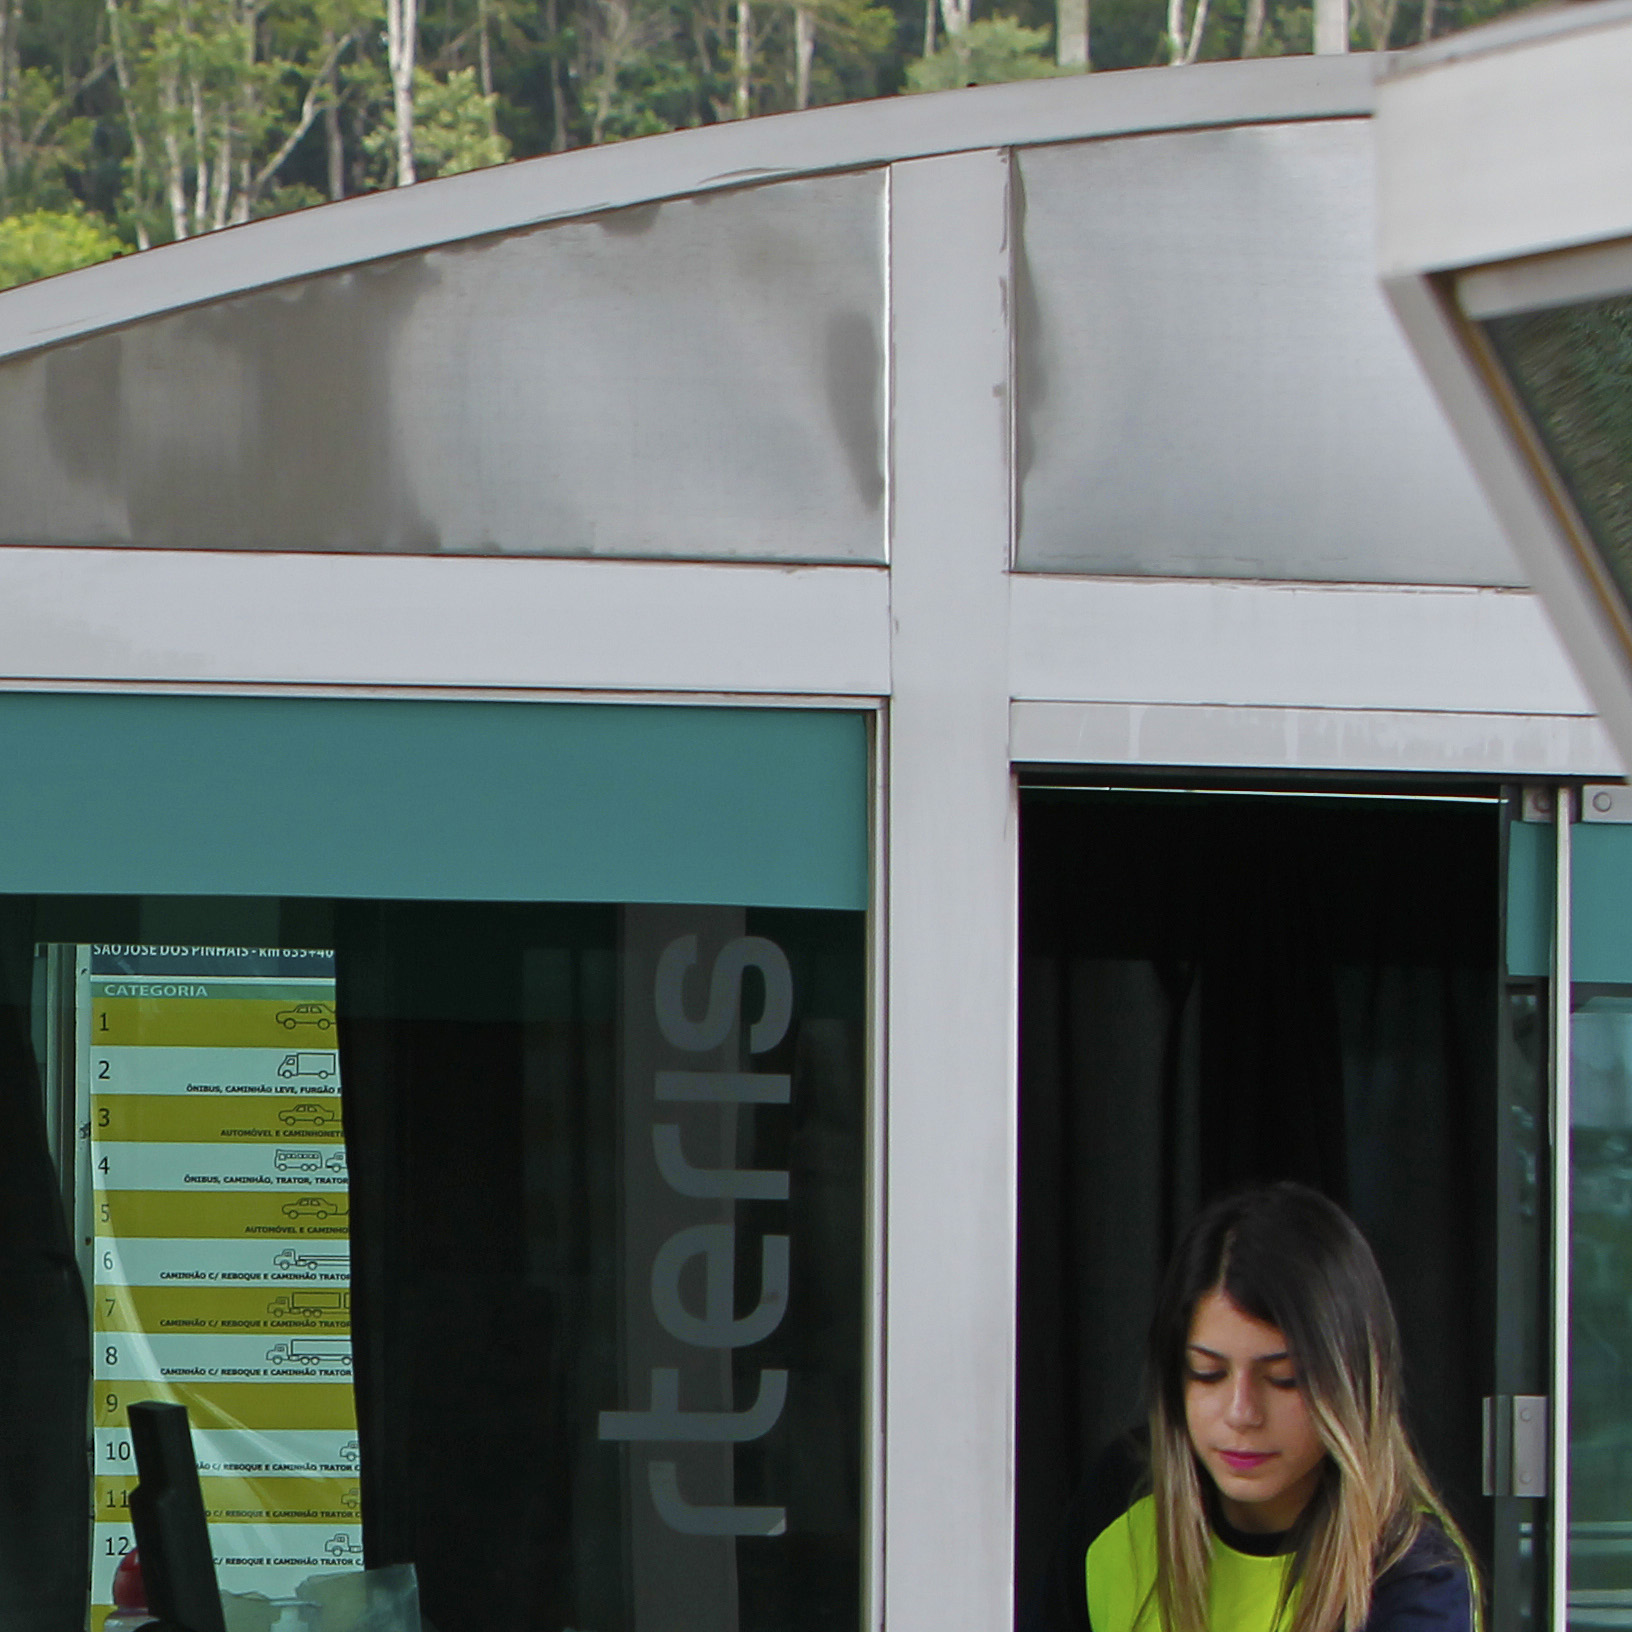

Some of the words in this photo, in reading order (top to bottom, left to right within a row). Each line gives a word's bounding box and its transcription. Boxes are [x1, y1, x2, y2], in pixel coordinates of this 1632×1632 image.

[104, 984, 208, 997] CATEGORIA
[99, 1012, 110, 1031] 1
[98, 1060, 111, 1080] 2
[98, 1108, 111, 1127] 3
[98, 1156, 111, 1175] 4
[100, 1203, 111, 1223] 5
[598, 934, 794, 1537] rteris
[103, 1251, 114, 1270] 6
[105, 1298, 116, 1317] 7
[105, 1346, 118, 1365] 8
[106, 1393, 118, 1412] 9
[106, 1441, 130, 1461] 10
[105, 1537, 129, 1556] 12
